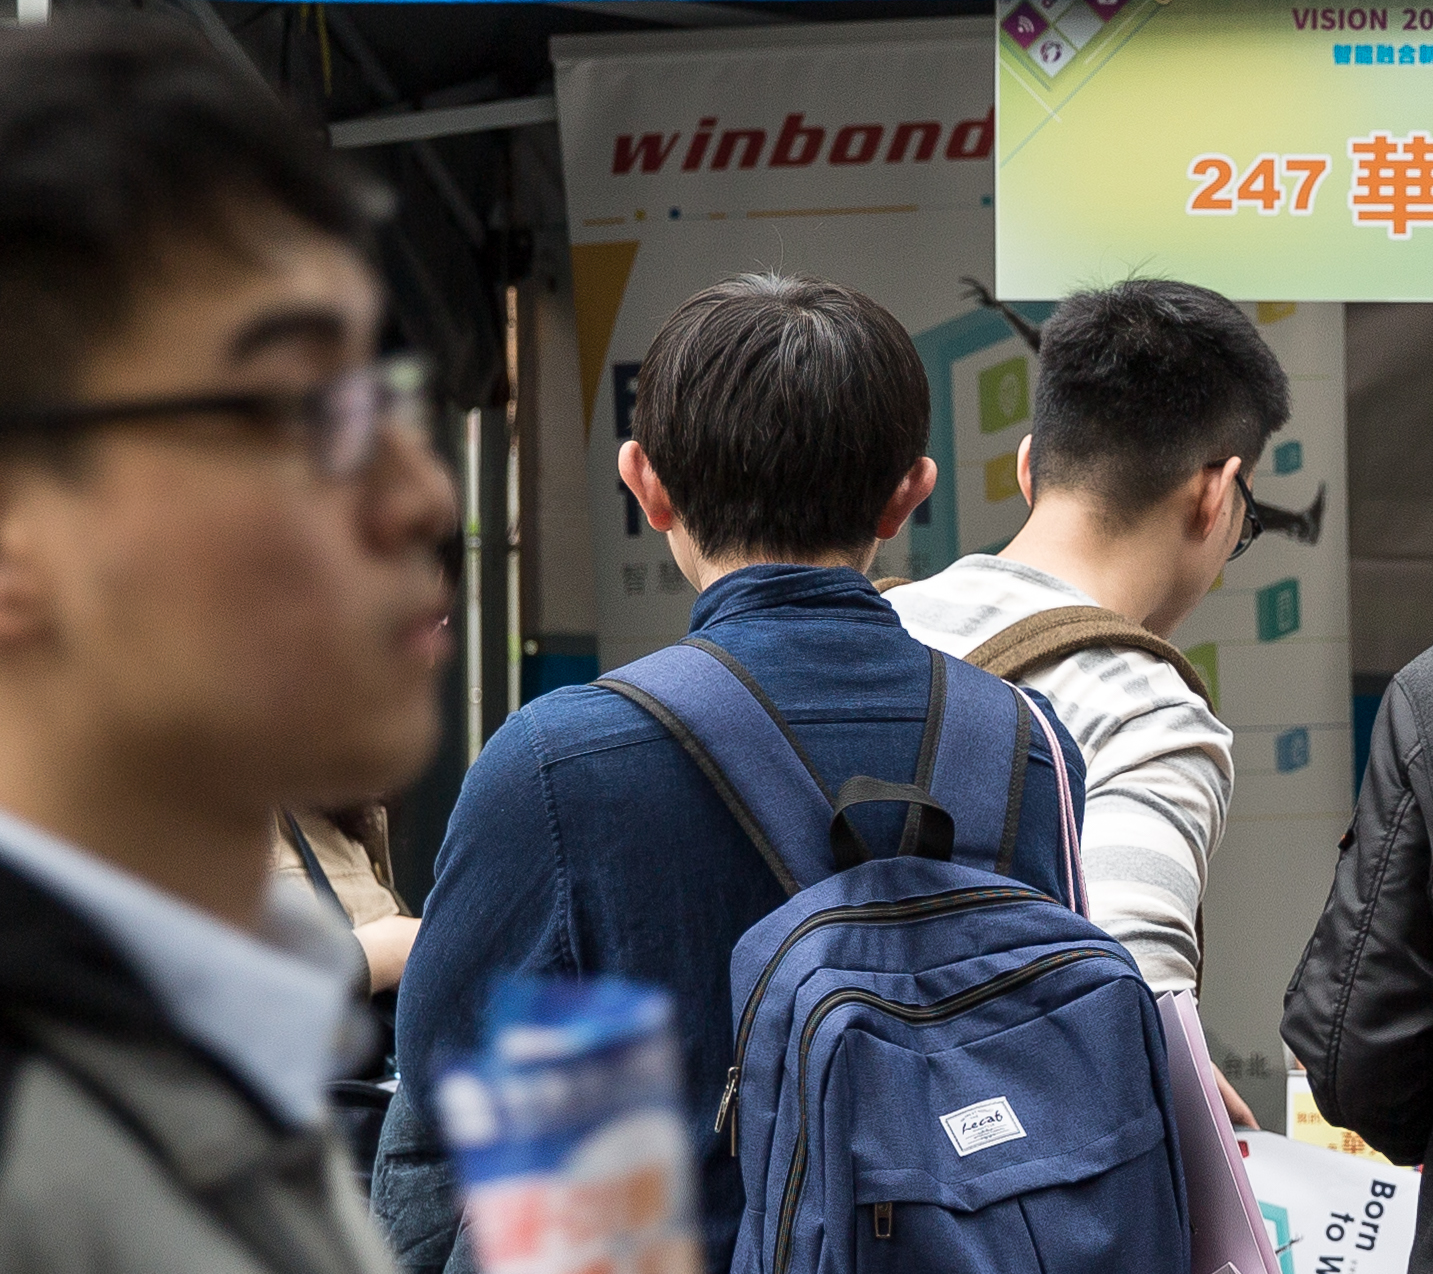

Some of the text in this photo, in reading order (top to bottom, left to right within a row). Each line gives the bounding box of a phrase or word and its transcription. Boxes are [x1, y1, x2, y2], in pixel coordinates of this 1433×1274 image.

[1291, 7, 1389, 31] VISION
[611, 111, 996, 176] winbond
[1189, 156, 1328, 213] 247
[1325, 1211, 1356, 1243] to
[1355, 1179, 1397, 1253] Born
